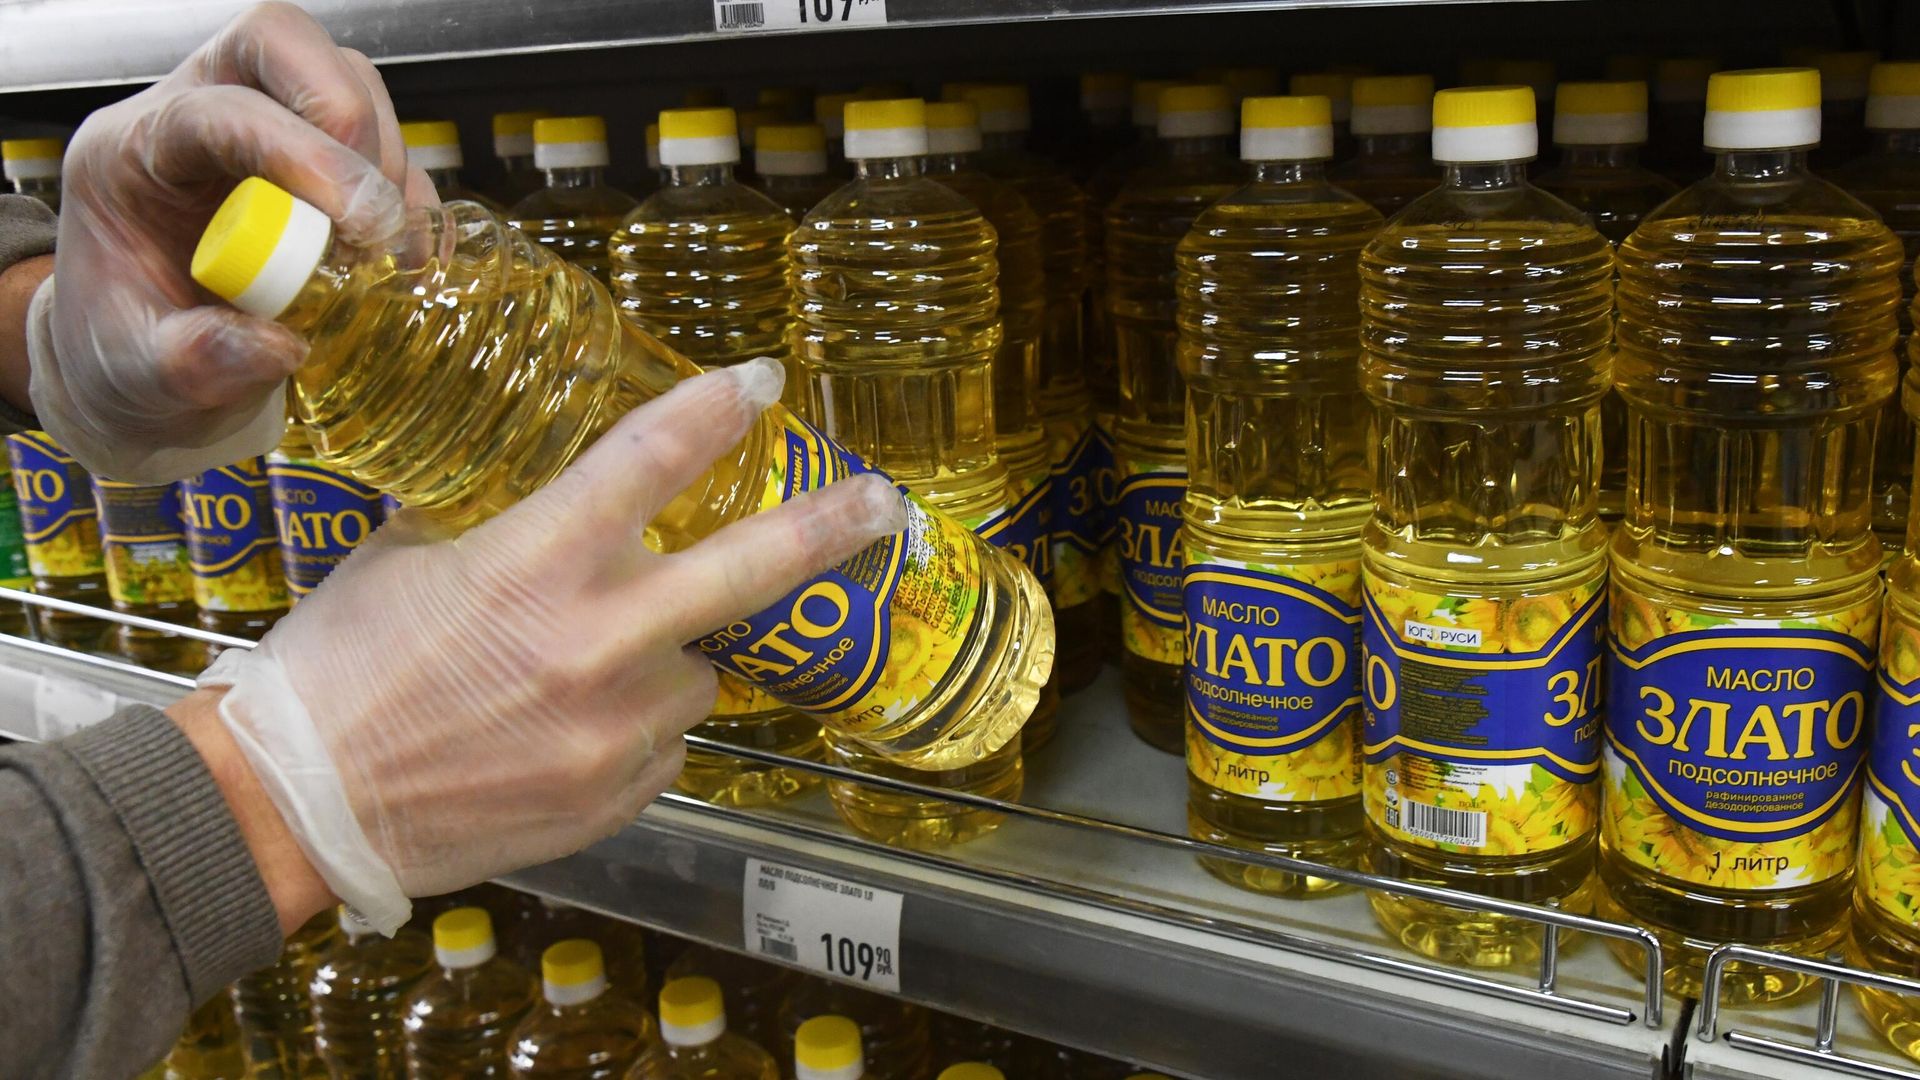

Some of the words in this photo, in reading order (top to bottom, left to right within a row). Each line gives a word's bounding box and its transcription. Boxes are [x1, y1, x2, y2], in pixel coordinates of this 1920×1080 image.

[1203, 595, 1280, 626] МАСЛО
[1408, 624, 1427, 637] ЮГ
[1440, 630, 1477, 645] РУСИ
[1706, 666, 1815, 692] МАСЛО
[1190, 674, 1313, 710] подсолнечное
[1636, 686, 1865, 761] ЗЛАТО
[1227, 764, 1270, 786] литр
[1668, 759, 1838, 787] подсолнечное
[1704, 800, 1804, 813] дезодорированное
[1706, 790, 1804, 803] рафинированное
[1712, 851, 1722, 870] 1
[1731, 853, 1789, 873] литр
[821, 933, 874, 981] 109
[876, 946, 891, 965] 90
